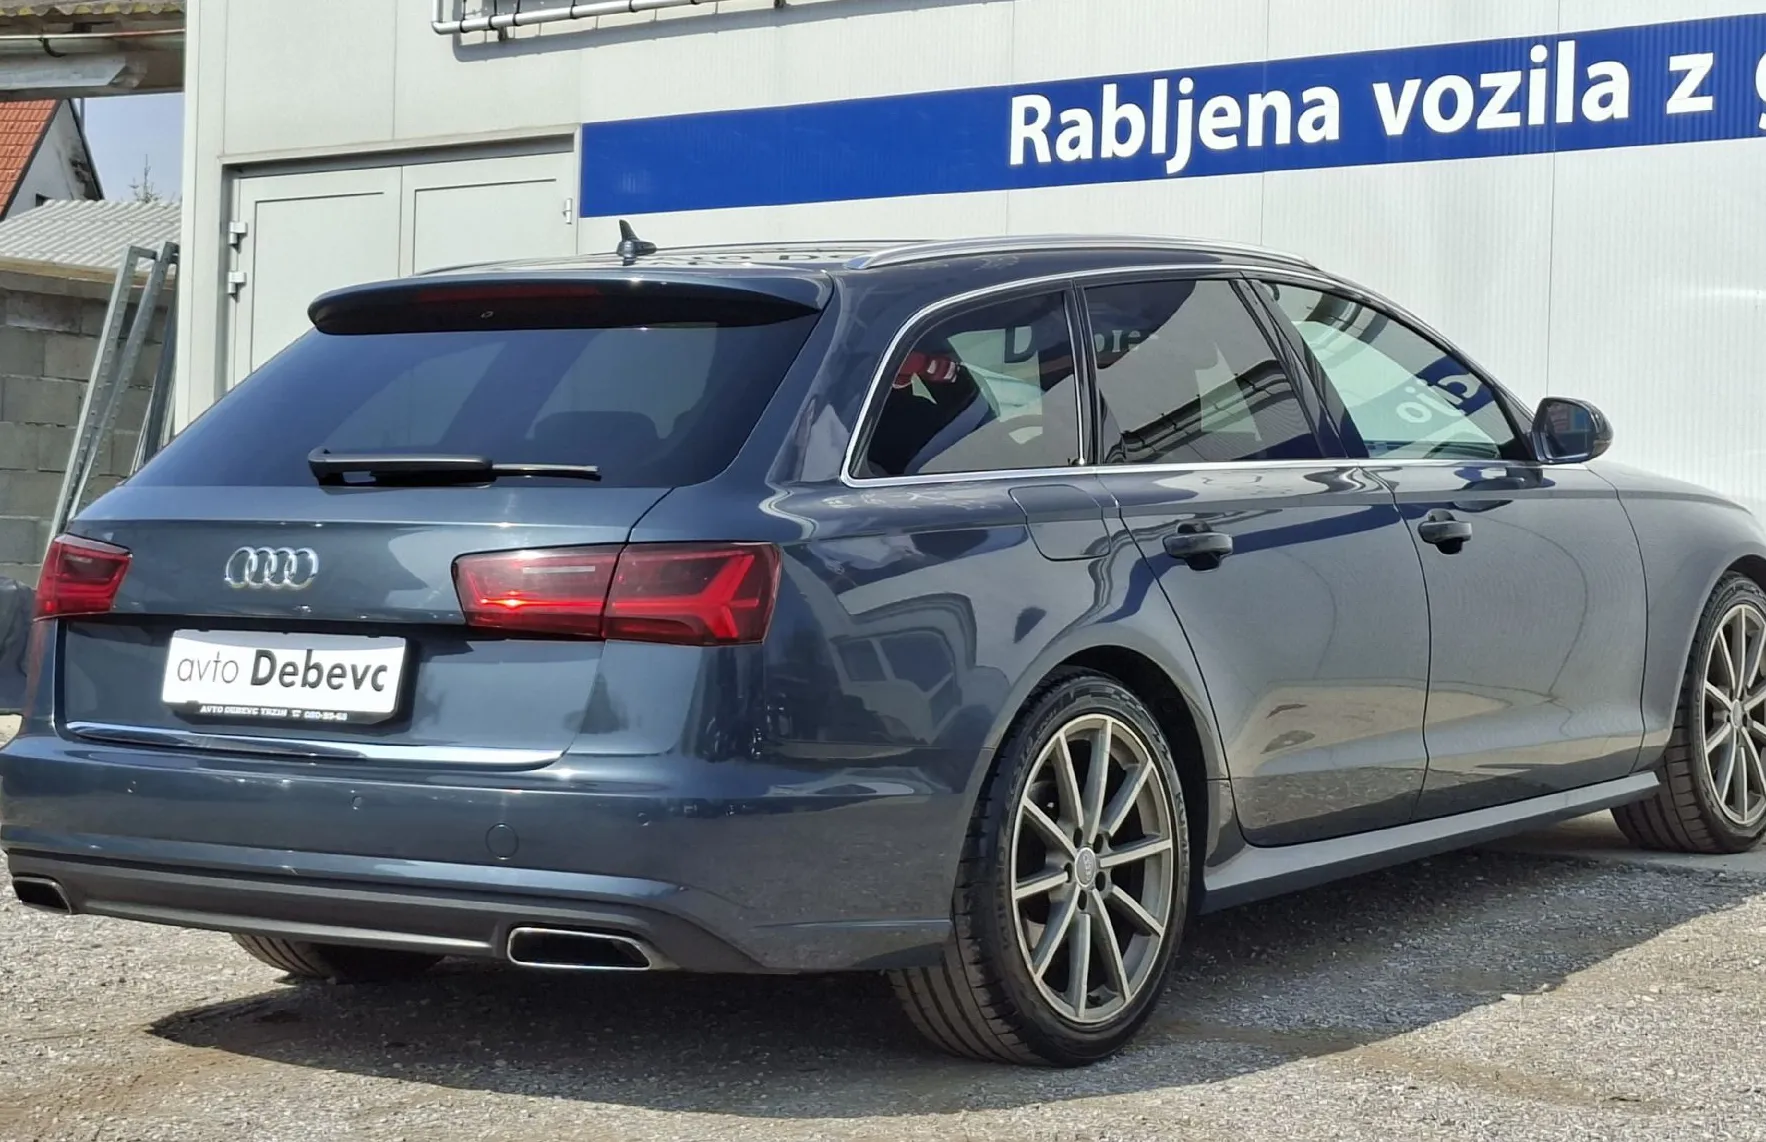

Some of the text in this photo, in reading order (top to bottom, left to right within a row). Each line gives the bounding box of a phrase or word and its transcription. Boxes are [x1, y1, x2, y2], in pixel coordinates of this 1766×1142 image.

[1009, 78, 1340, 174] Rabljena
[1373, 40, 1630, 136] vozila
[1666, 52, 1715, 115] z
[177, 649, 388, 692] avto Debevc
[200, 704, 224, 714] AVTO
